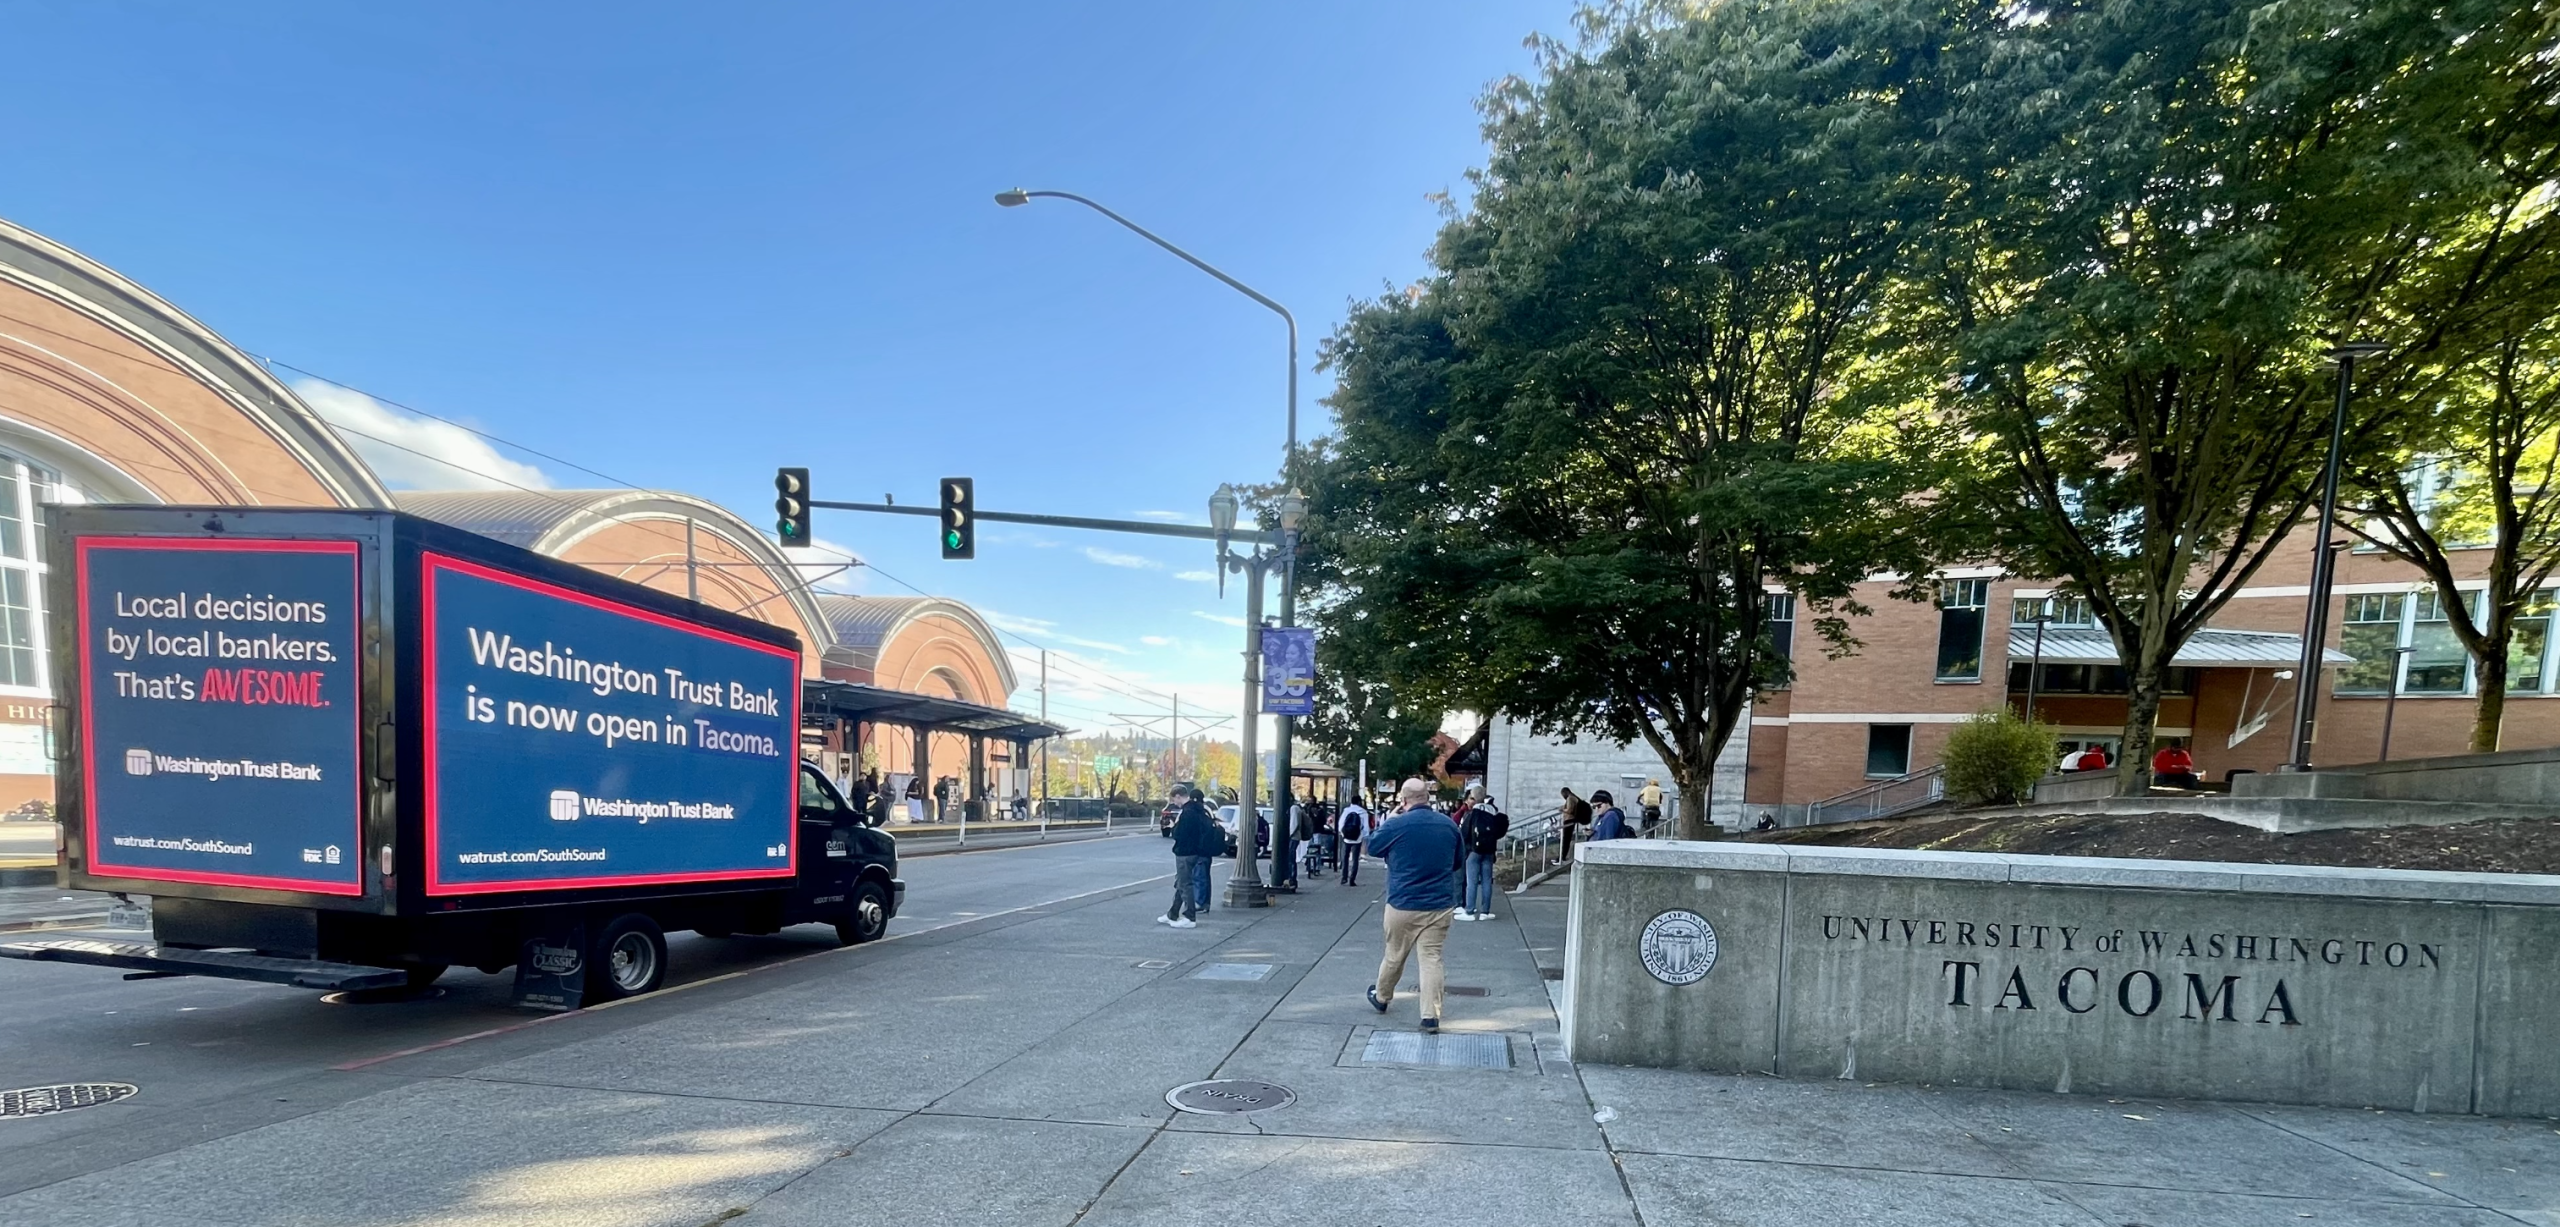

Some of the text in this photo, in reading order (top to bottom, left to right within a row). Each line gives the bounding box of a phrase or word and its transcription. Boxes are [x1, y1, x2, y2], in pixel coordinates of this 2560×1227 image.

[117, 591, 326, 624] Local decisions
[108, 627, 337, 662] by local bankers.
[467, 627, 779, 717] Washington Trust Bank
[1268, 667, 1306, 697] 35
[114, 668, 331, 708] That's AWESOME.
[467, 685, 780, 757] is now open in Tacoma.
[155, 755, 322, 782] Washington Trust Bank
[583, 797, 734, 824] Washington Trust Bank
[114, 836, 252, 855] watrust.com/SouthSound
[459, 848, 606, 864] watrust.com/SouthSound
[1667, 912, 1684, 920] OF
[1822, 915, 2444, 972] UNIVERSITY of WASHINGTON
[1942, 959, 2302, 1027] TACOMA
[1201, 1089, 1261, 1104] DRAIN
